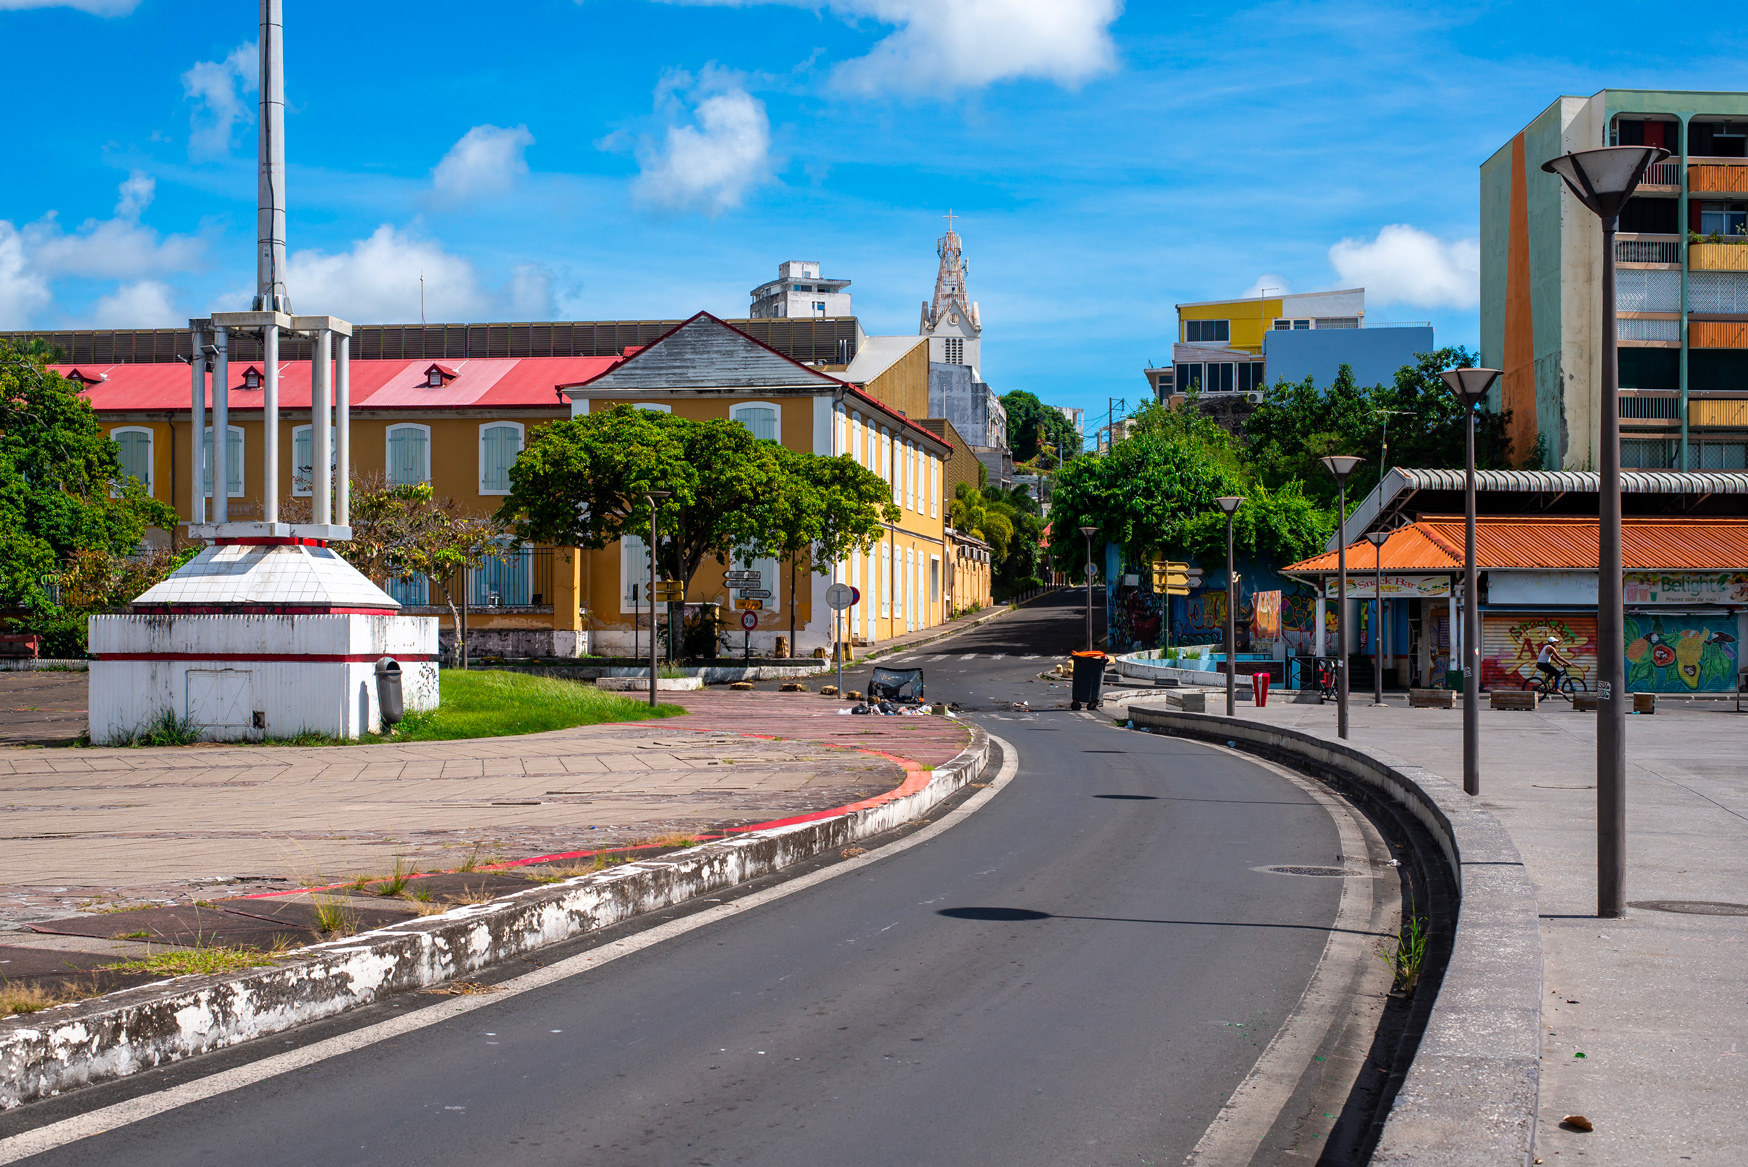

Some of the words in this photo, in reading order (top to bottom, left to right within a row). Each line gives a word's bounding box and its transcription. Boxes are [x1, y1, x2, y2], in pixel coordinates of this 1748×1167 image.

[1357, 576, 1392, 590] Snack
[1395, 577, 1417, 589] Bar
[1661, 576, 1716, 596] Belight
[1508, 617, 1553, 644] Snack
[1552, 619, 1576, 645] Bar
